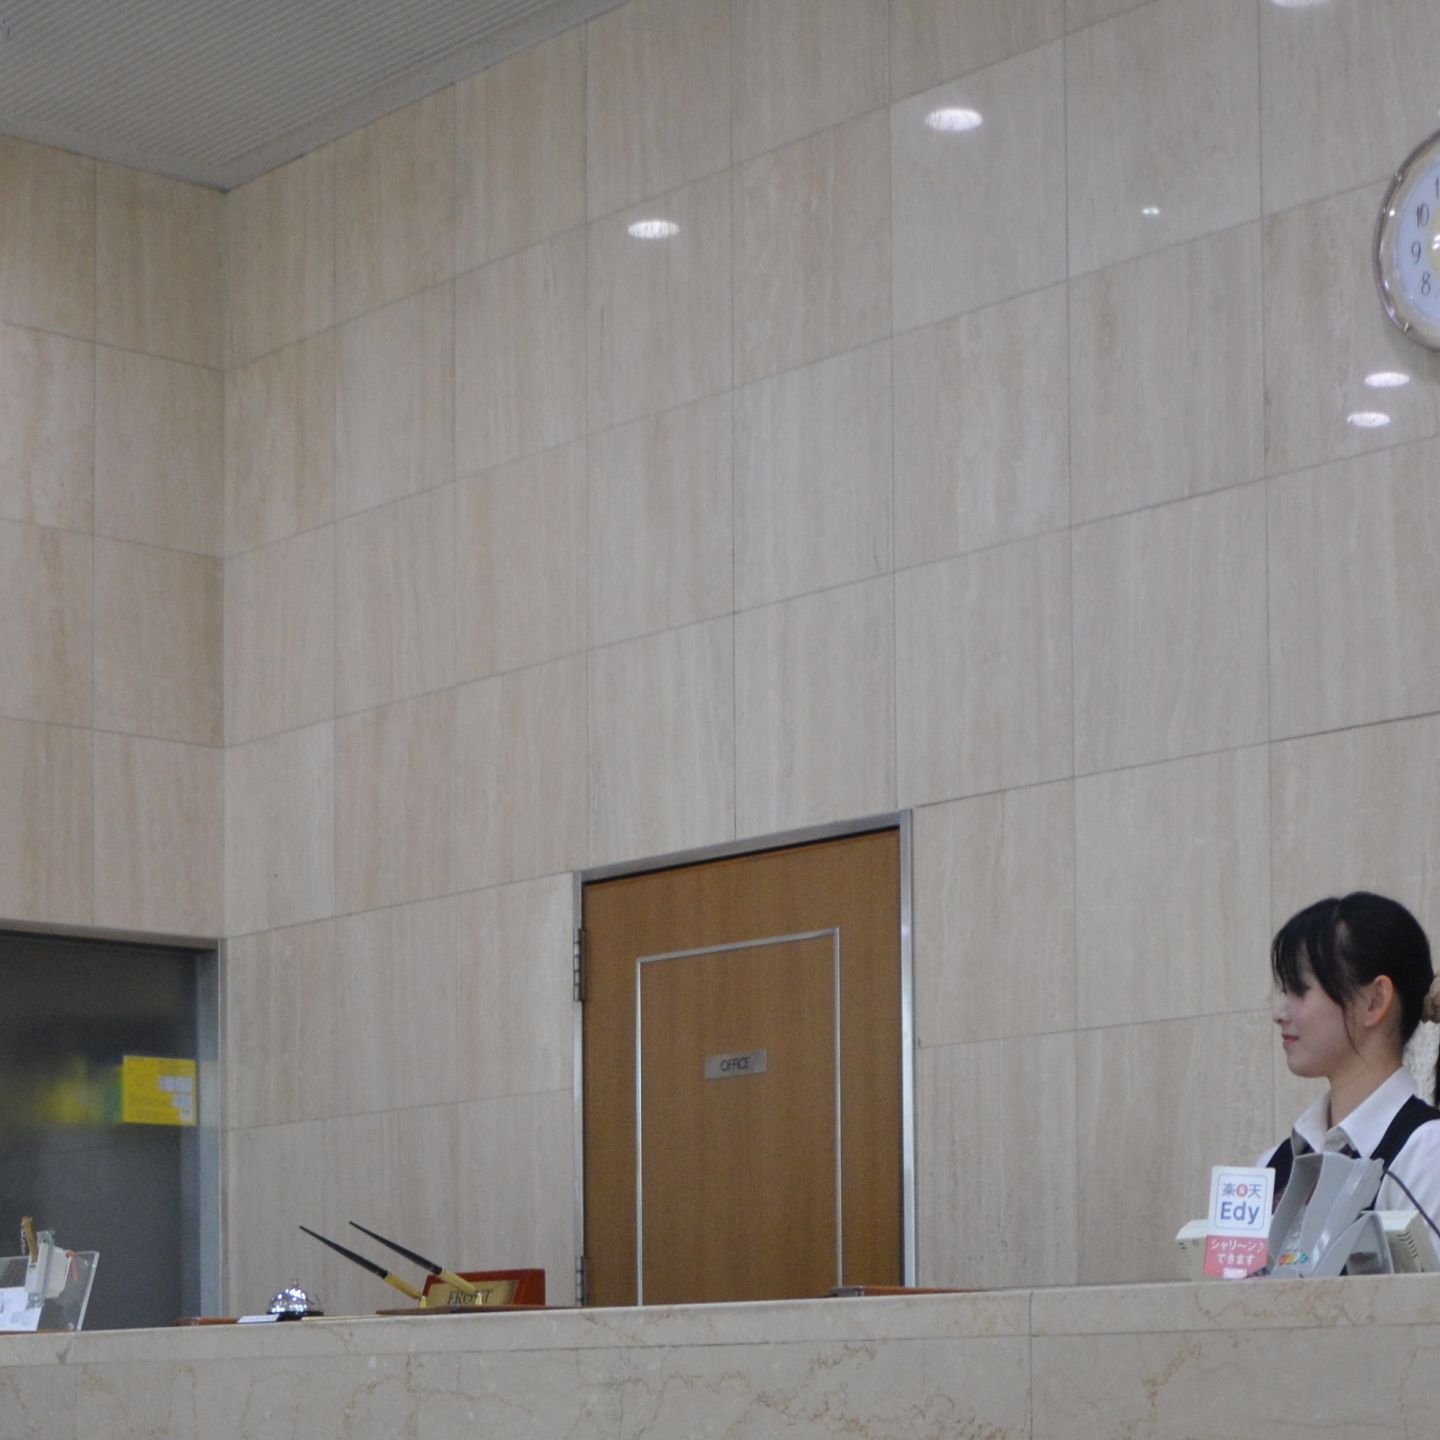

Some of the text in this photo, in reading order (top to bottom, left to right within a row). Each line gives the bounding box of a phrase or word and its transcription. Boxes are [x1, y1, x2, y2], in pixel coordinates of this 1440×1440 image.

[1416, 203, 1430, 228] 10
[1411, 240, 1421, 265] 9
[1421, 271, 1431, 297] 8
[720, 1056, 751, 1072] OFFICE
[1220, 1201, 1260, 1225] Edy
[1217, 1254, 1255, 1265] できます
